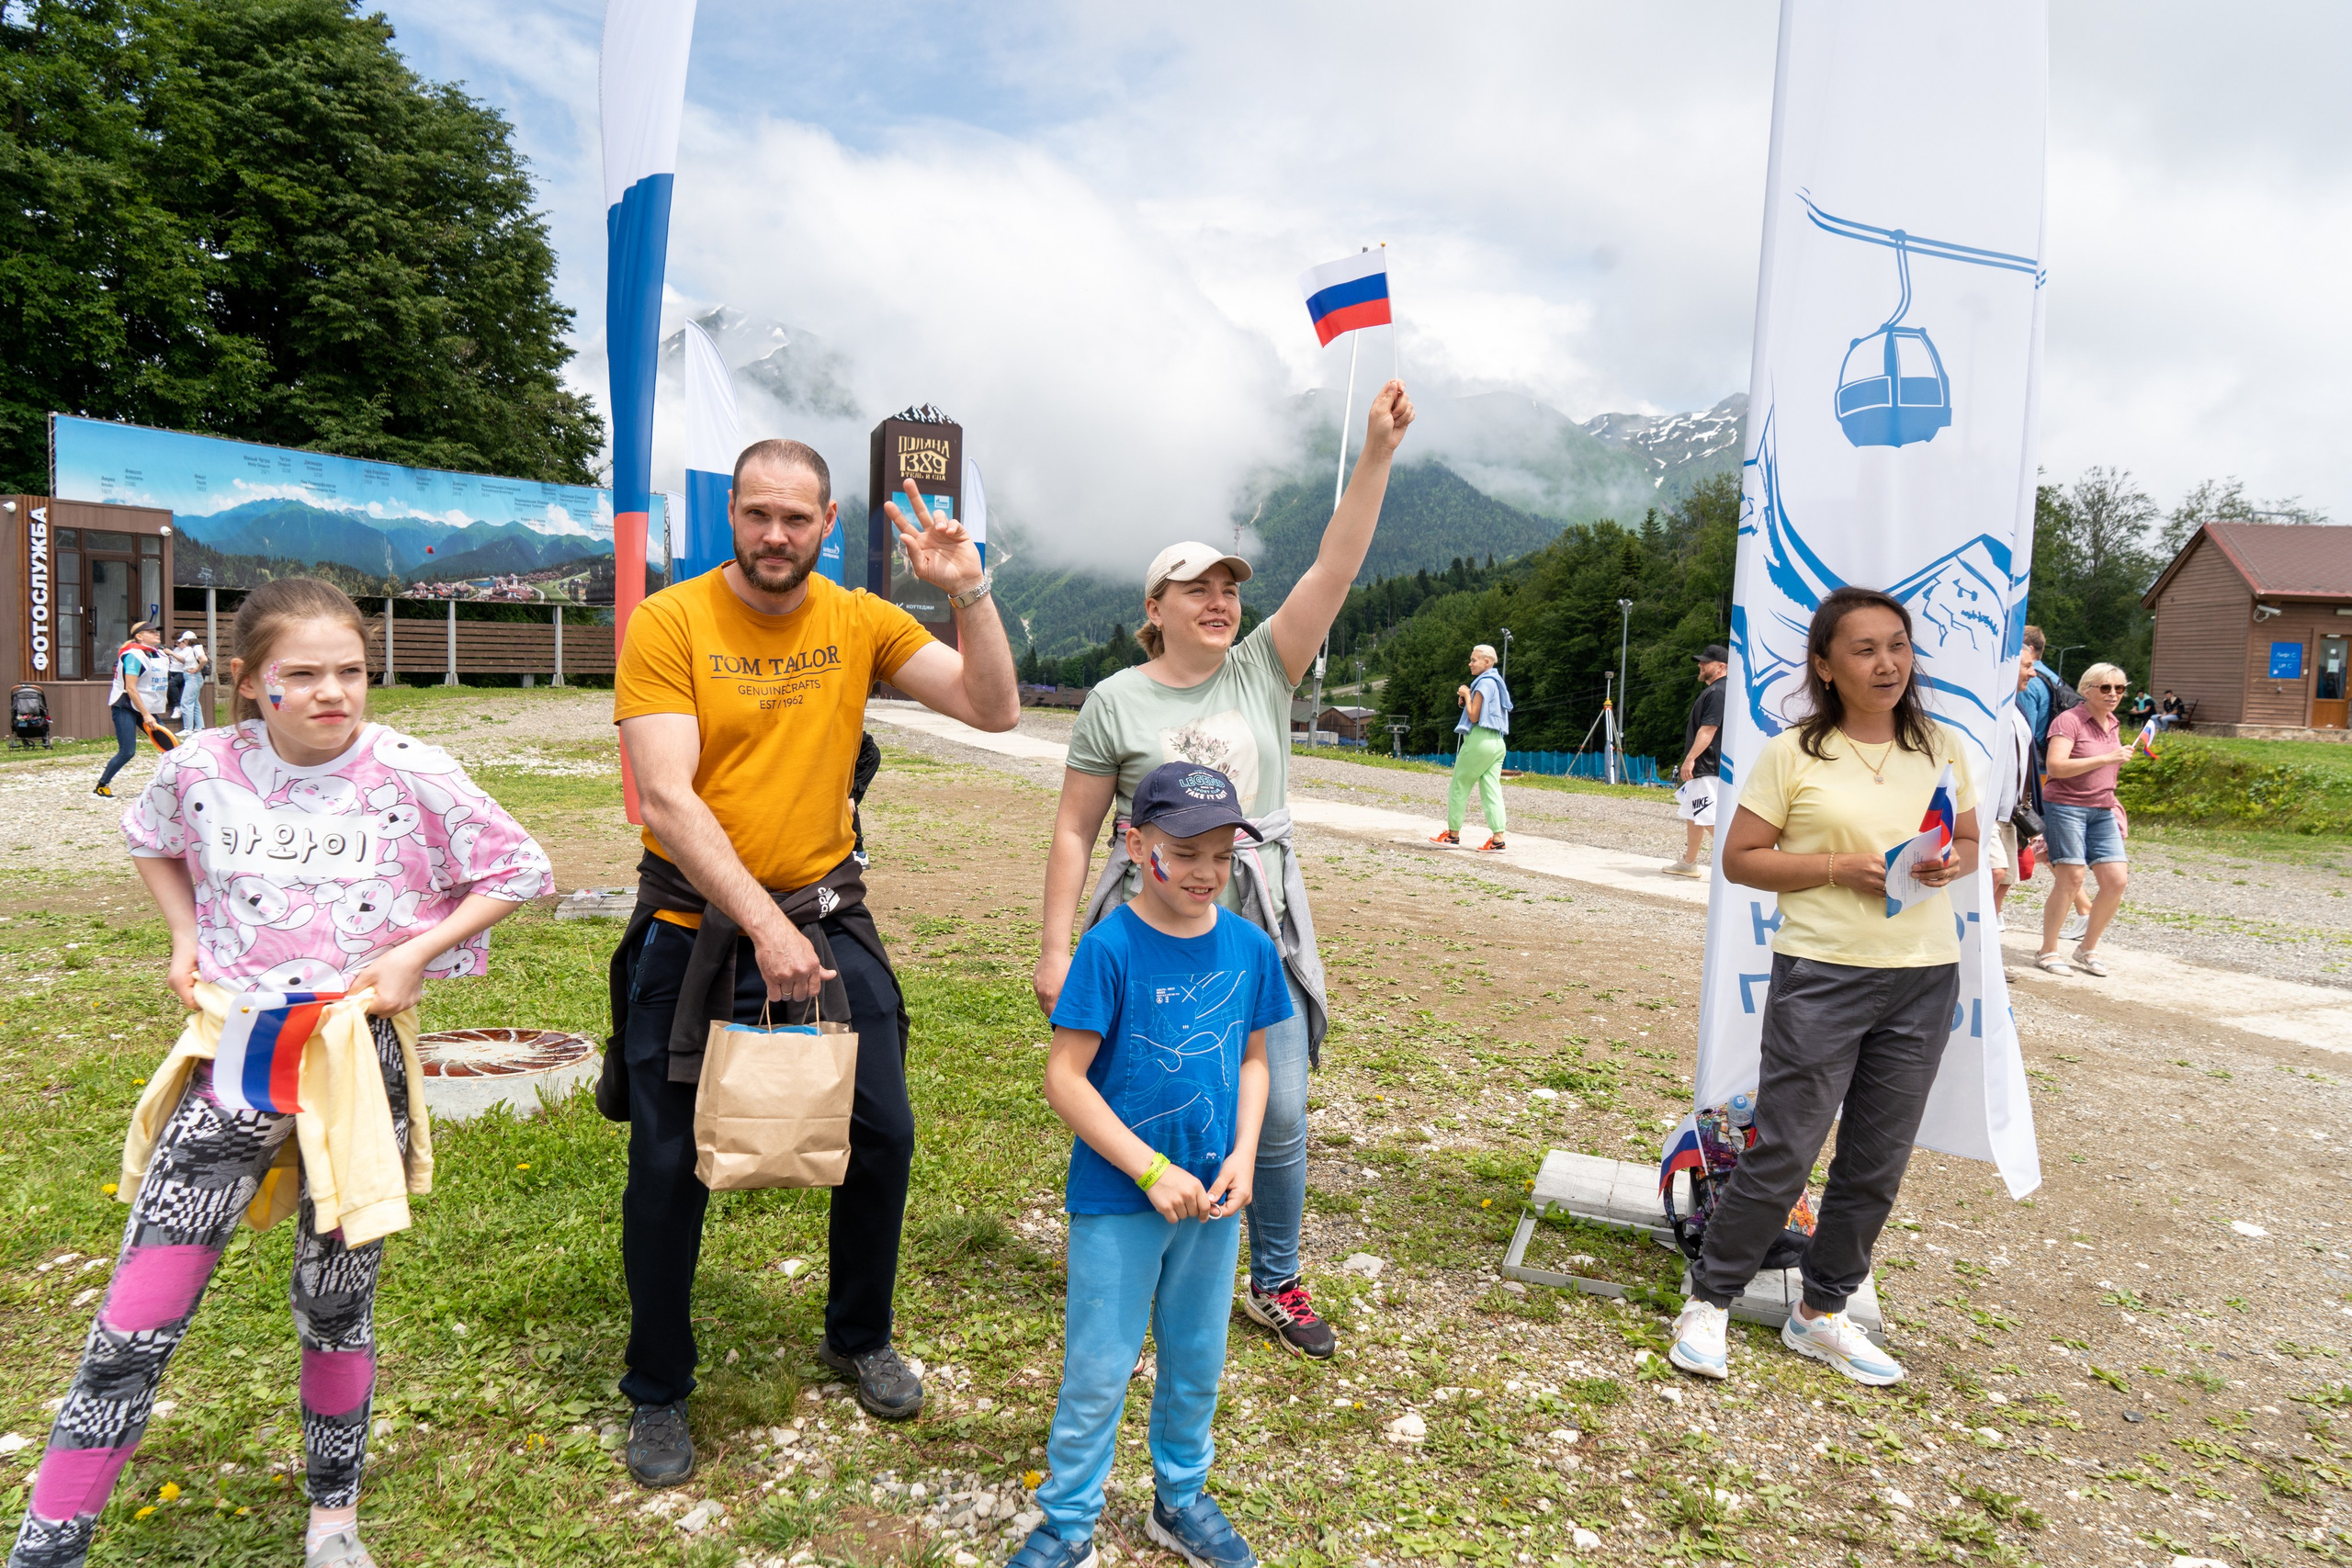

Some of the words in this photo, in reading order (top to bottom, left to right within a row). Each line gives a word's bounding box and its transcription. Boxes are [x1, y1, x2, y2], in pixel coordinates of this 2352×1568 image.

[899, 435, 950, 458] ПОЛЯНА
[899, 452, 946, 475] 1389
[29, 506, 49, 671] ФОТОСЛУЖБА
[709, 654, 763, 676] TOM
[768, 645, 842, 676] TAILOR
[738, 683, 786, 696] GENUINE
[785, 679, 821, 695] CRAFTS
[1185, 788, 1205, 799] TAKE
[1691, 795, 1709, 810] NIKE
[221, 823, 367, 863] 카와이
